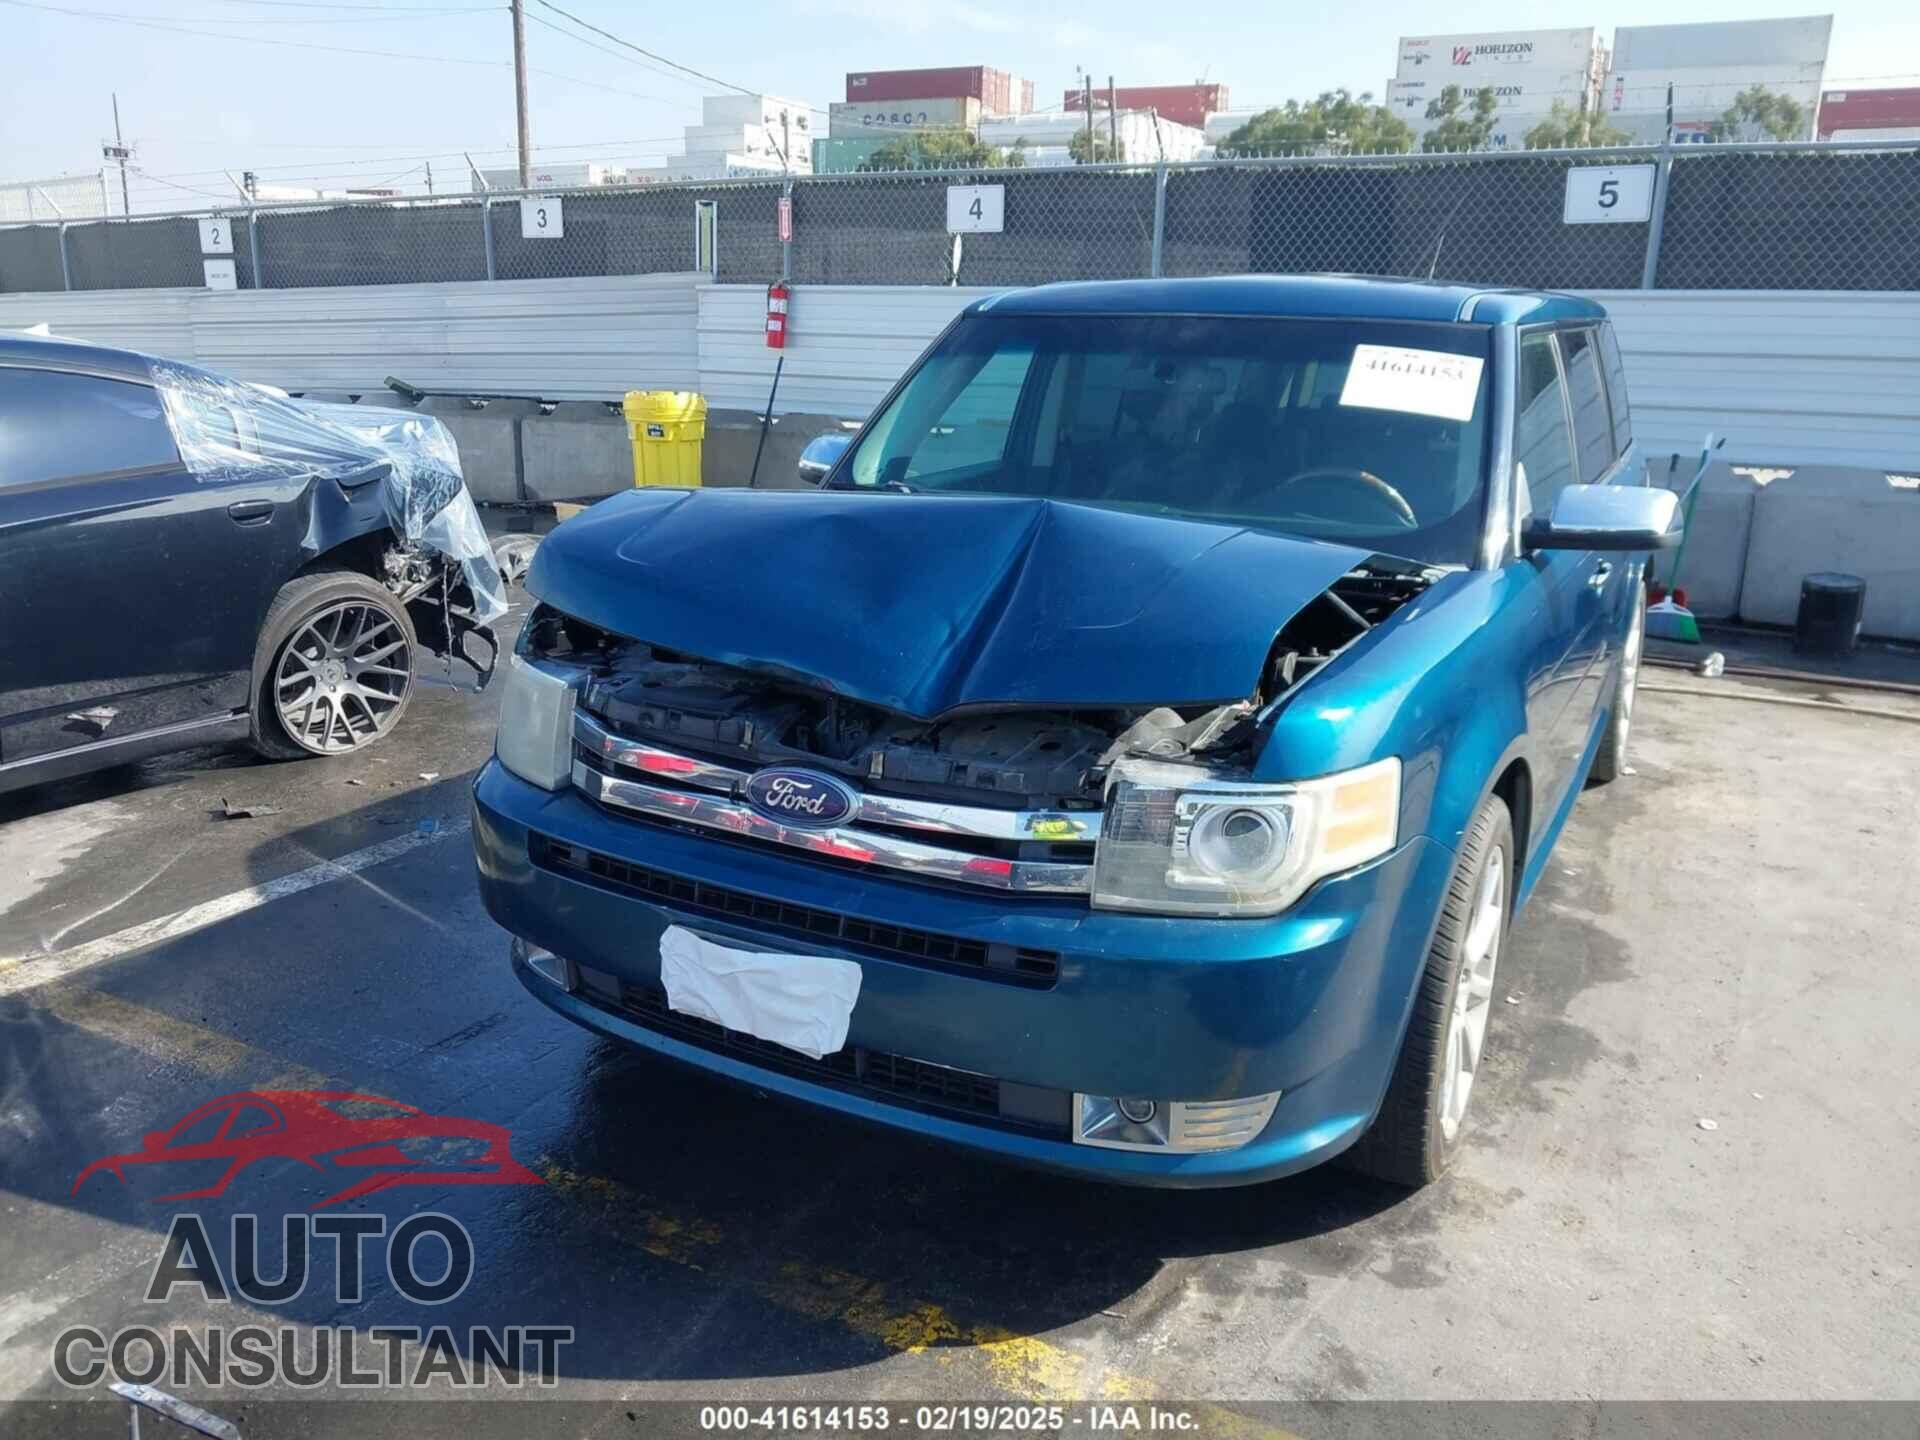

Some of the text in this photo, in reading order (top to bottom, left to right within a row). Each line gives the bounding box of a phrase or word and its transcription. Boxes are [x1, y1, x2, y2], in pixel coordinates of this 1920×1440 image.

[1475, 42, 1533, 55] HORIZON
[863, 111, 928, 126] COSCO
[1598, 180, 1619, 208] 5
[537, 208, 547, 228] 3
[969, 198, 983, 220] 4
[211, 227, 221, 245] 2
[766, 777, 827, 815] Ford
